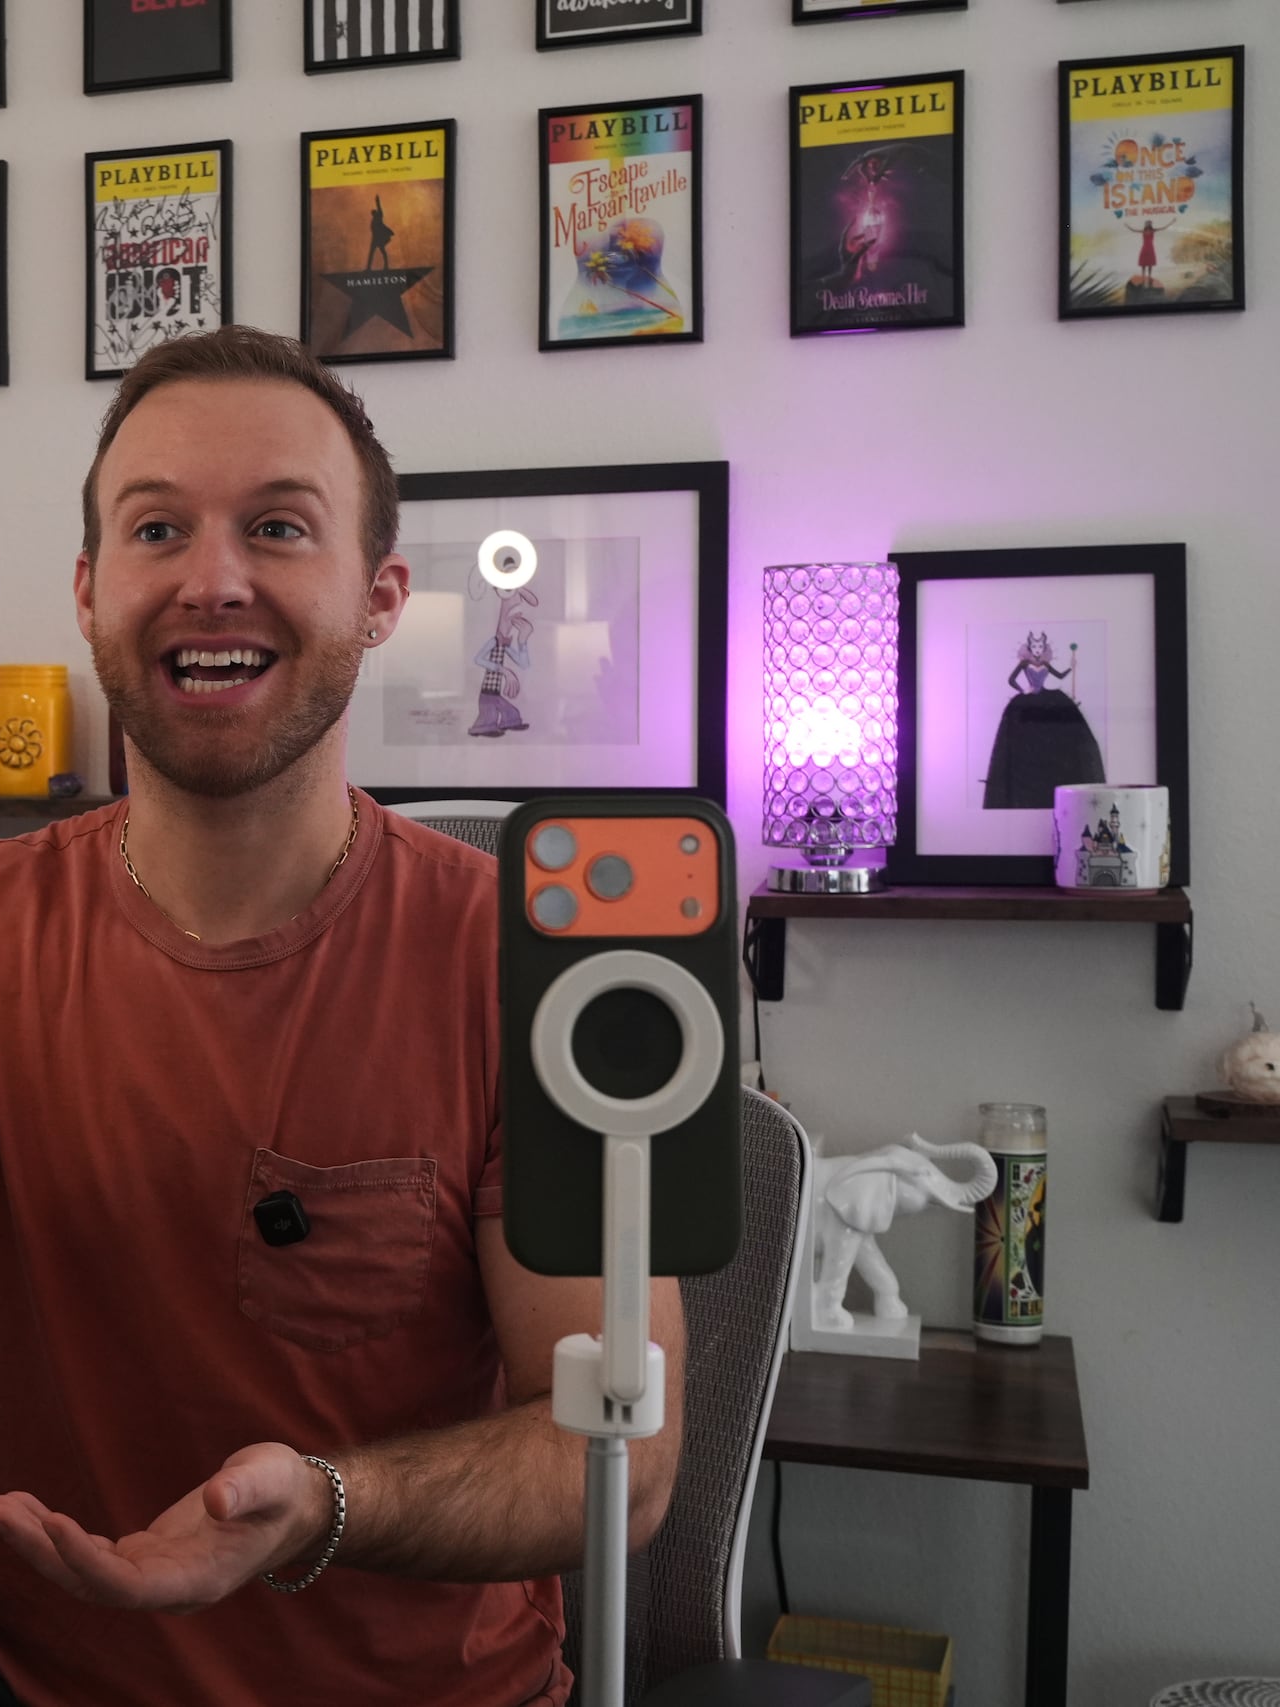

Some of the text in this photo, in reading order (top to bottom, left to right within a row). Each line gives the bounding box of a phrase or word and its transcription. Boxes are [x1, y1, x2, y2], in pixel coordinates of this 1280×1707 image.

[1072, 67, 1221, 99] PLAYBILL
[800, 93, 946, 124] PLAYBILL
[551, 112, 688, 143] PLAYBILL
[315, 140, 439, 167] PLAYBILL
[1115, 138, 1186, 169] ONCE
[99, 160, 214, 188] PLAYBILL
[568, 161, 649, 208] Escape
[1103, 176, 1196, 209] ISLAND
[552, 168, 688, 257] Margaritaville
[346, 274, 407, 288] HAMILTON
[816, 288, 855, 311] Death
[855, 286, 905, 311] Becomes
